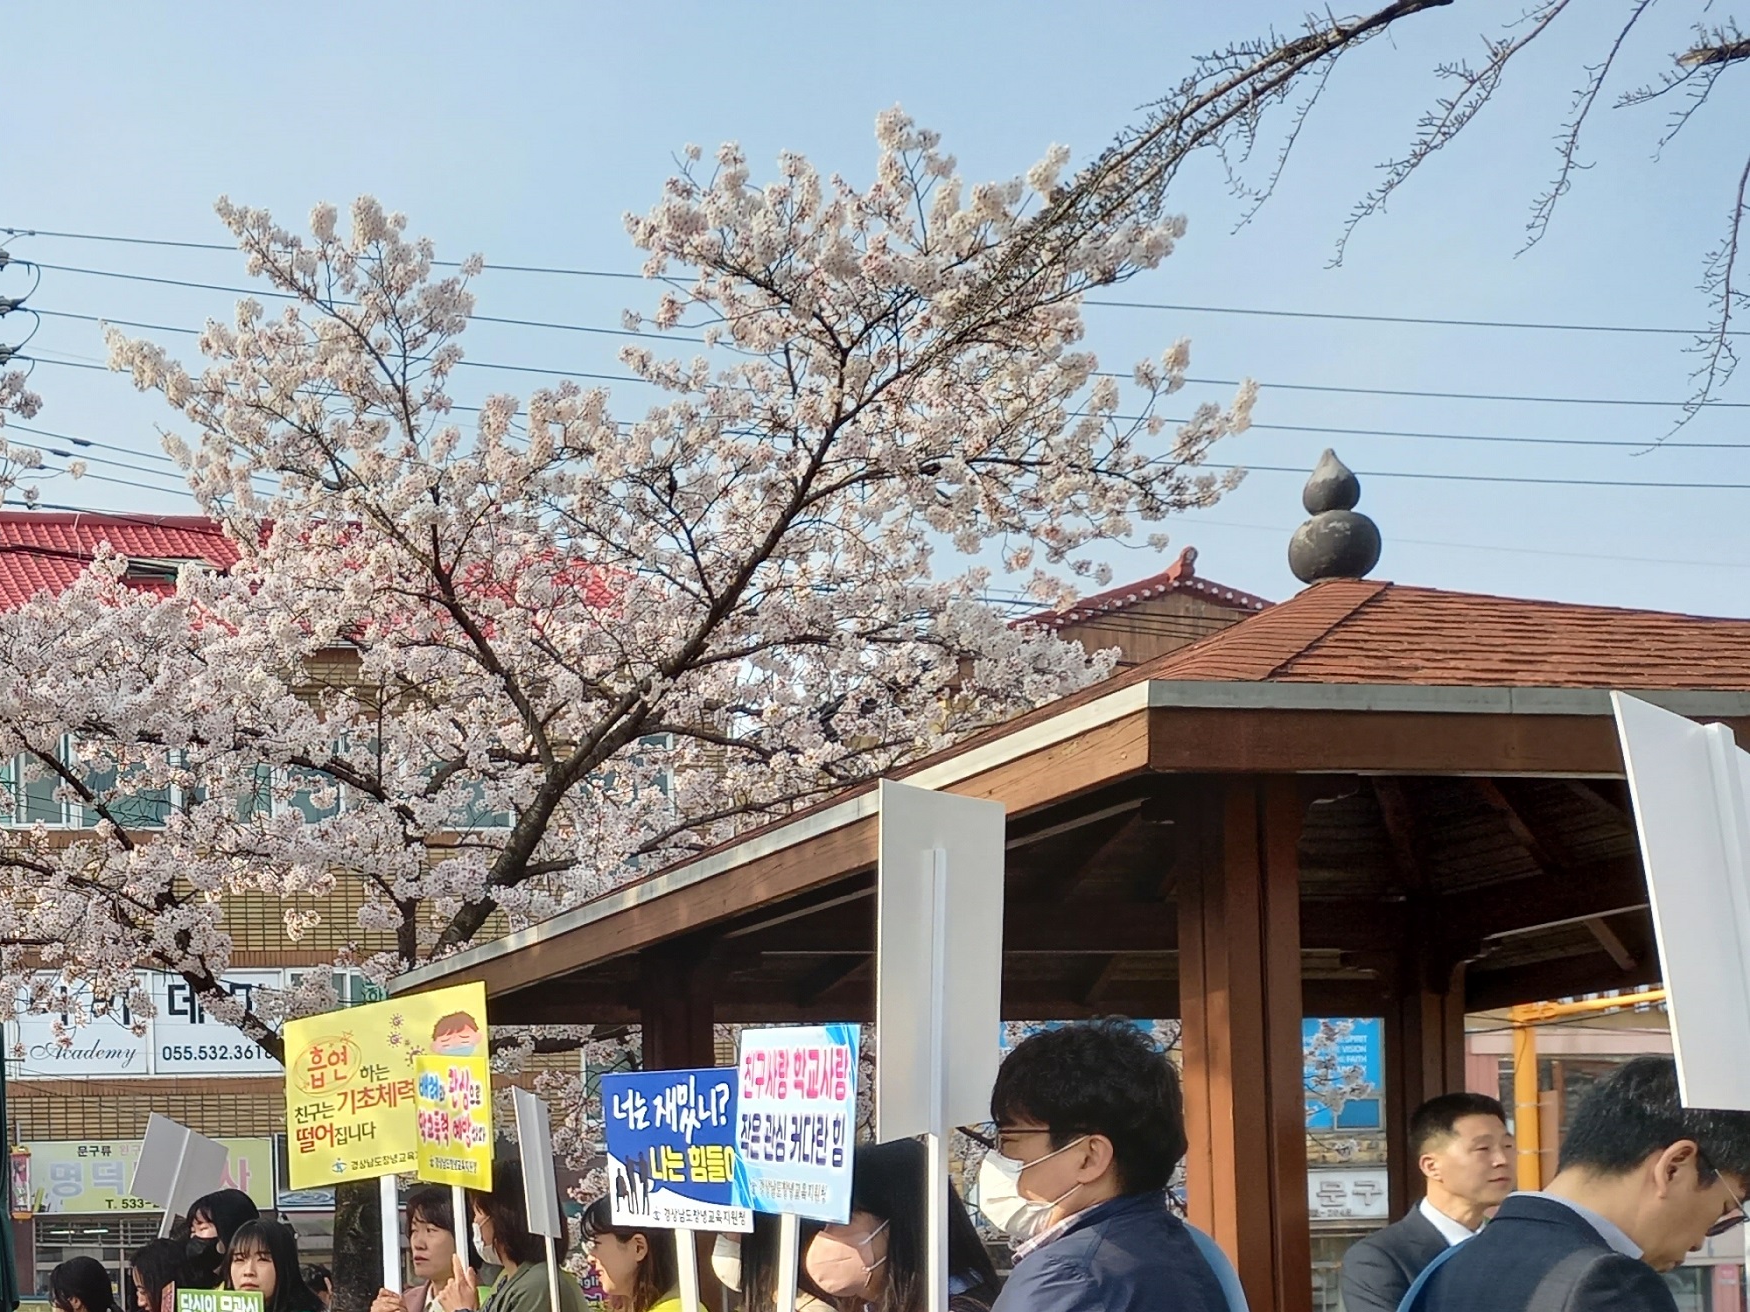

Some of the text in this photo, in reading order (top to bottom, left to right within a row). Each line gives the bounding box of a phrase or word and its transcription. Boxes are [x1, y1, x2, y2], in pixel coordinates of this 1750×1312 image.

[29, 1038, 138, 1068] Academy
[307, 1045, 390, 1090] 흡연 하는
[744, 1046, 849, 1101] 친구사랑 학교사랑
[294, 1102, 335, 1124] 친구는
[614, 1089, 650, 1131] 너는
[77, 1145, 112, 1157] 문구류
[296, 1121, 376, 1154] 떨어집니다
[742, 1113, 846, 1168] 작은 관심 커다란 힘
[650, 1145, 686, 1183] 나는
[663, 1208, 746, 1226] 경상남도창녕교육지원청
